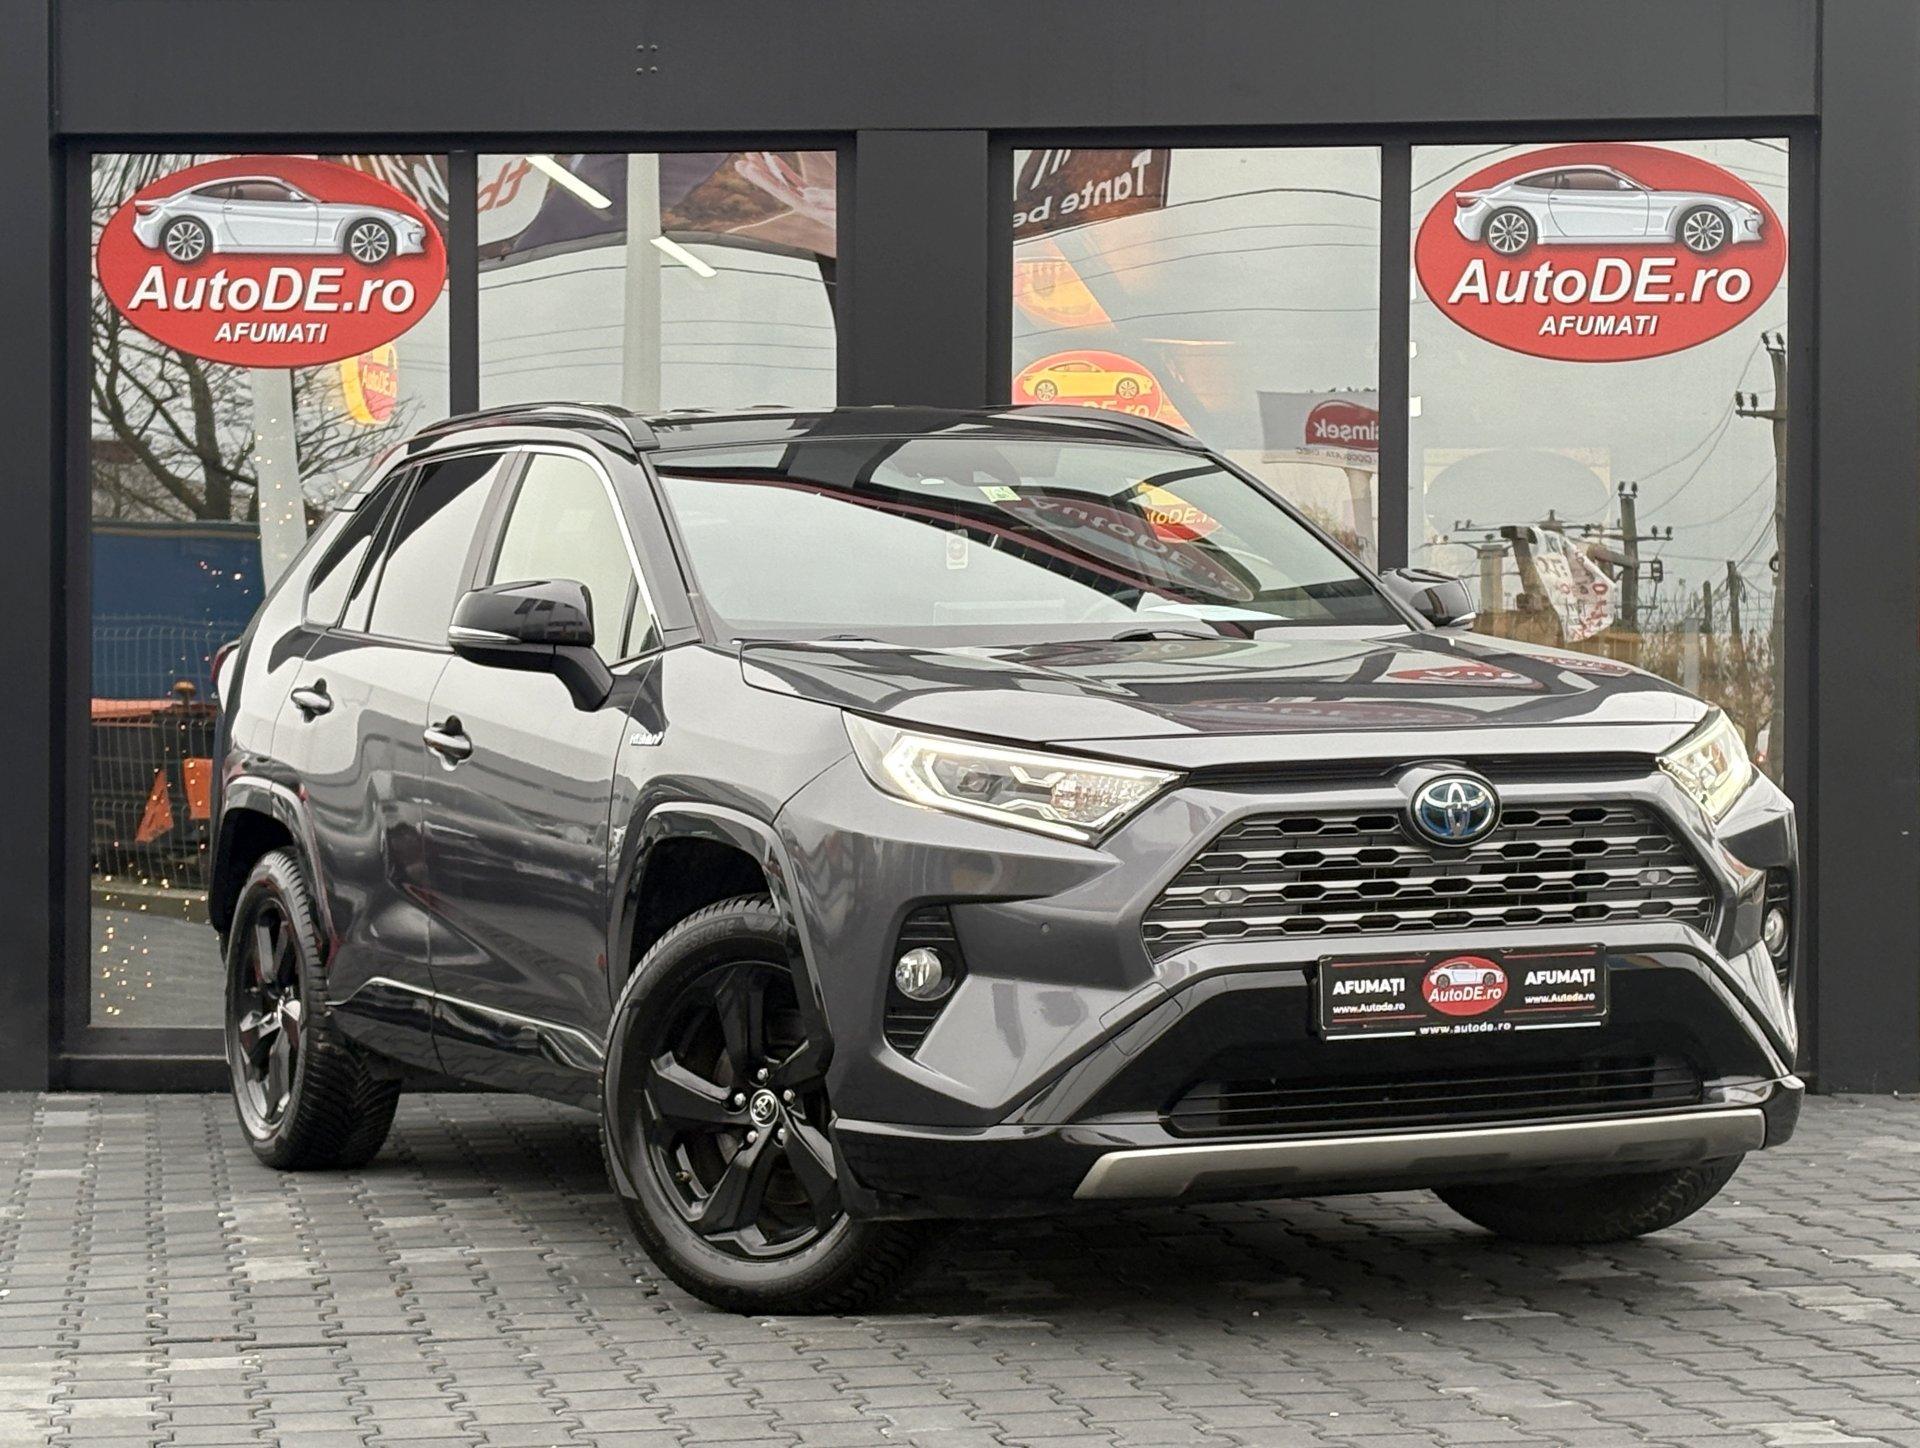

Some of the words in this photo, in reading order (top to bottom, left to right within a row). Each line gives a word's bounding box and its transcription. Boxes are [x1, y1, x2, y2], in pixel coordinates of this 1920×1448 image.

[127, 264, 416, 313] AutoDE.ro
[1447, 256, 1753, 304] AutoDE.ro
[214, 322, 329, 344] AFUMATI
[1538, 315, 1659, 337] AFUMATI
[1427, 985, 1503, 1003] AutoDE.ro
[1420, 1021, 1512, 1035] www.autode.ro
